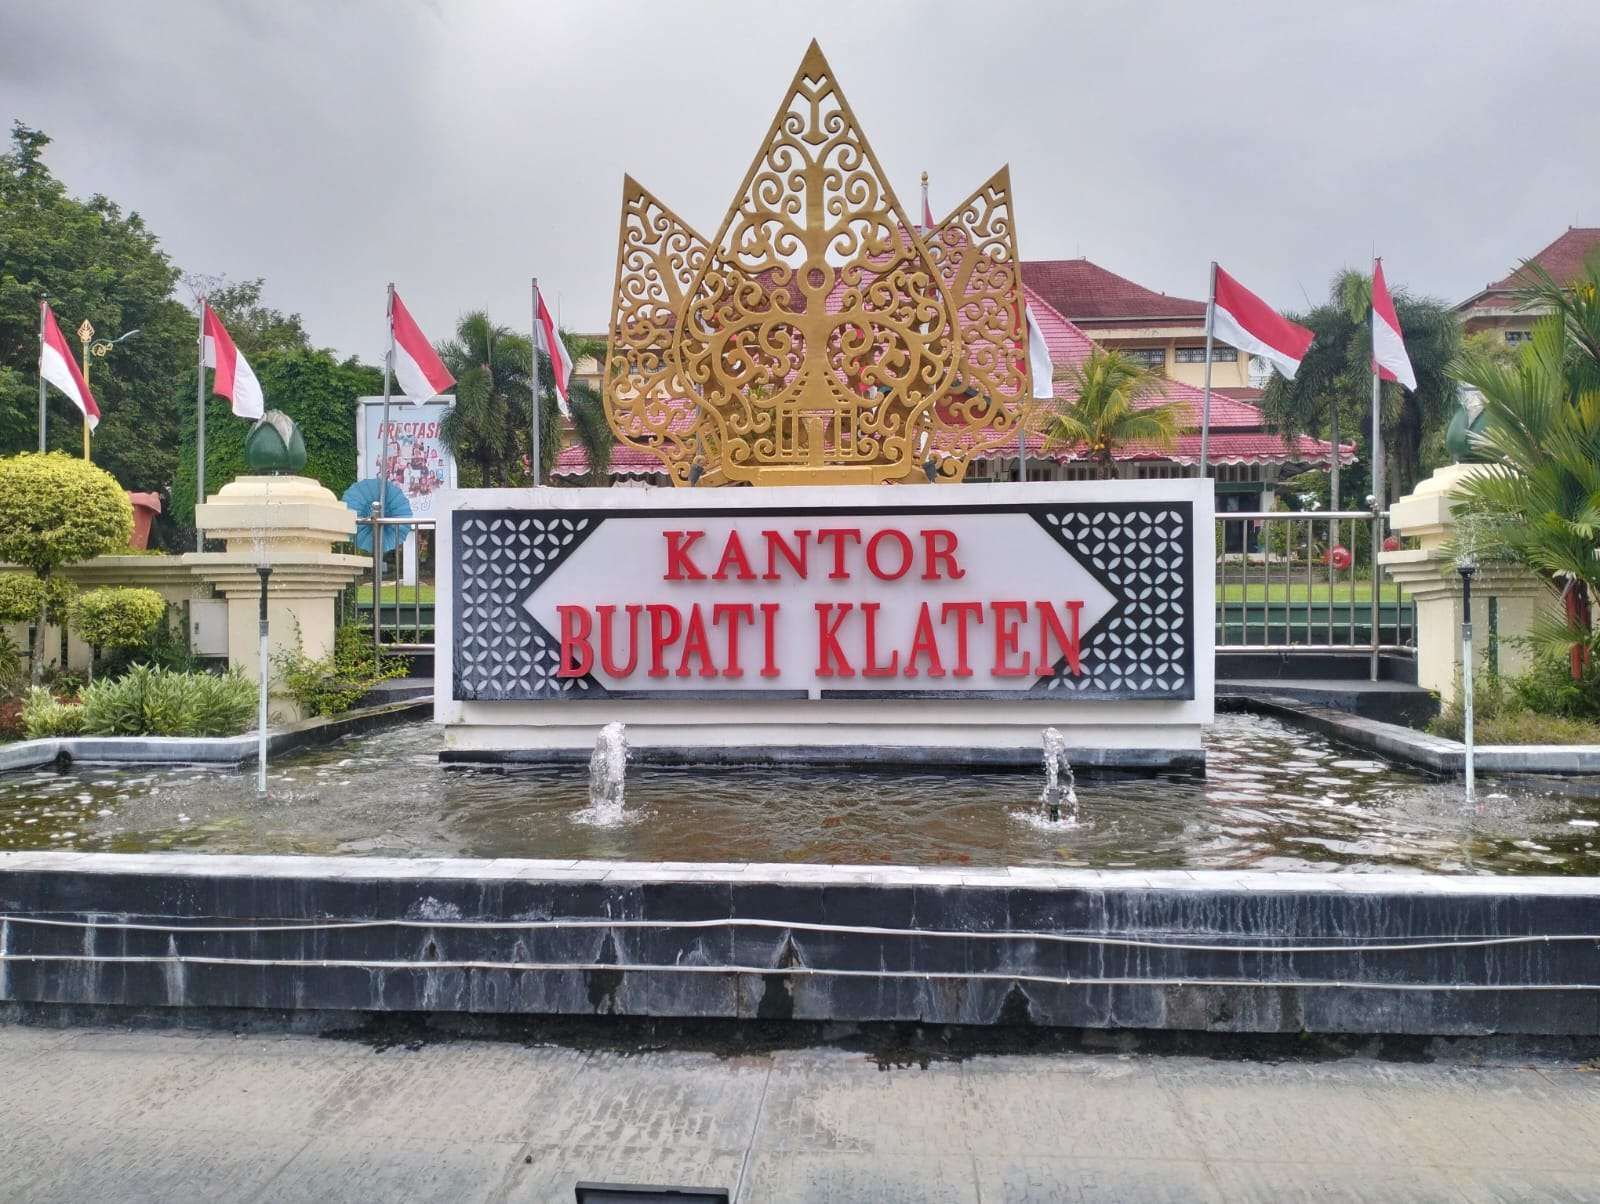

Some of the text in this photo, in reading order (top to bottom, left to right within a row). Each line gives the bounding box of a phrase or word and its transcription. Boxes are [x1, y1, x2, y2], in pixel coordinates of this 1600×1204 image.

[663, 528, 966, 581] KANTOR
[556, 601, 1084, 679] BUPATI KLATEN
